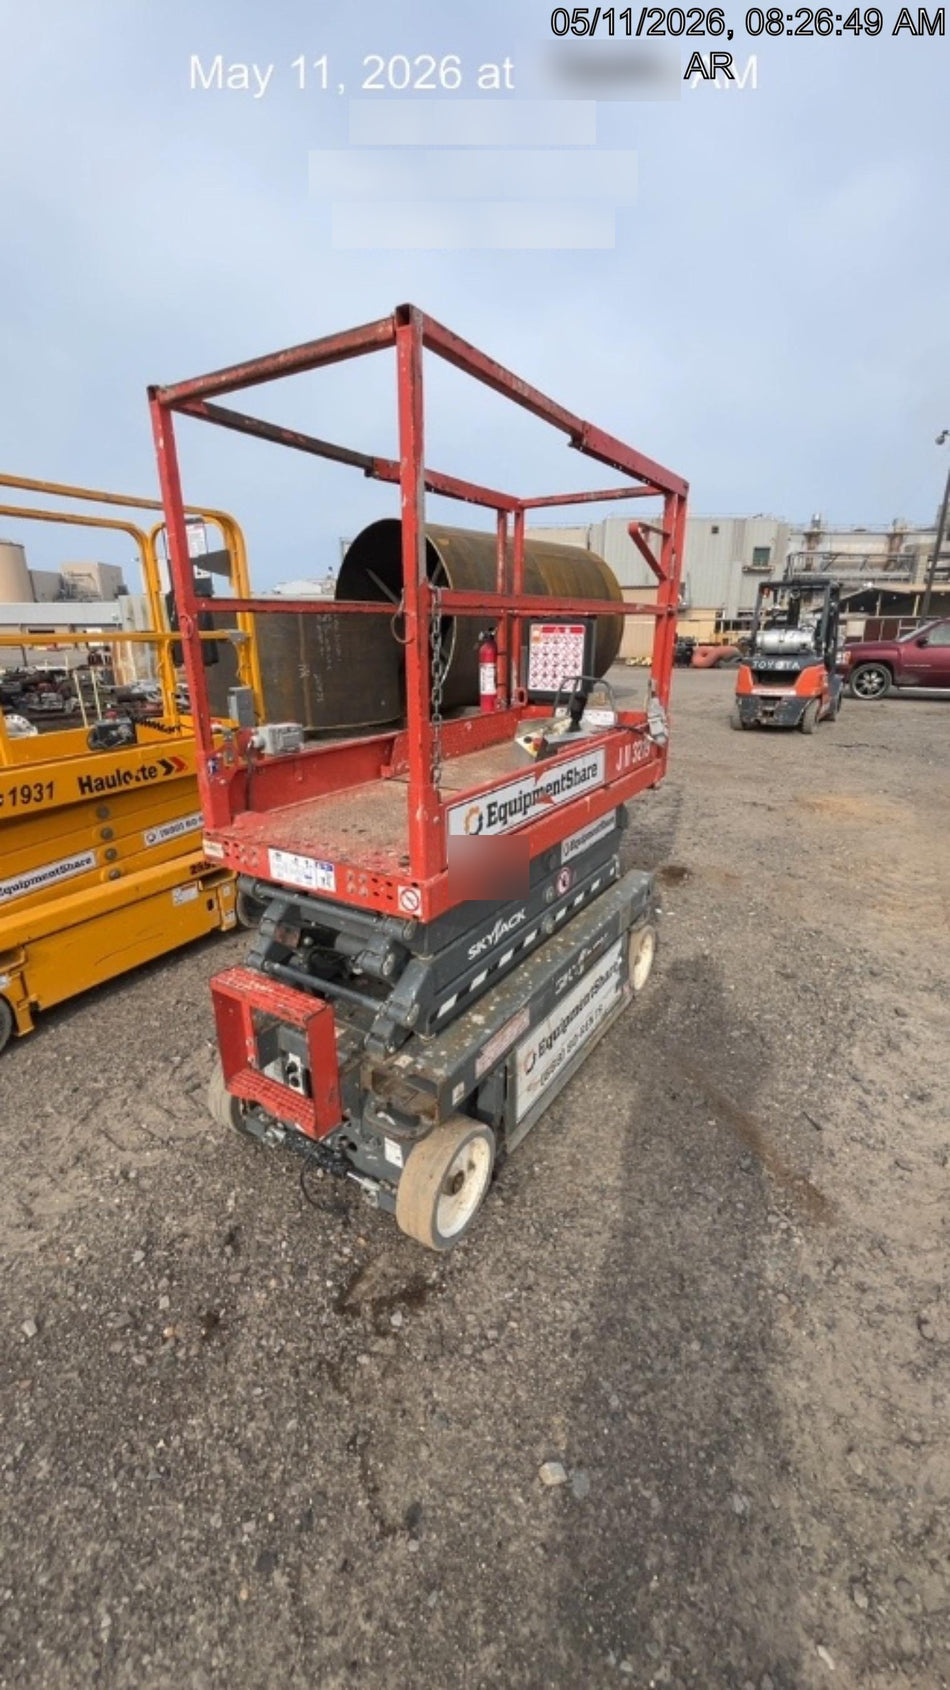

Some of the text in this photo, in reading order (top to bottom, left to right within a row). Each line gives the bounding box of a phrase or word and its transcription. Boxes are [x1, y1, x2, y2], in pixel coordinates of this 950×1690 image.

[752, 660, 800, 670] TOYOTA
[486, 763, 598, 828] EquipmentShare
[467, 906, 527, 961] SKYJACK
